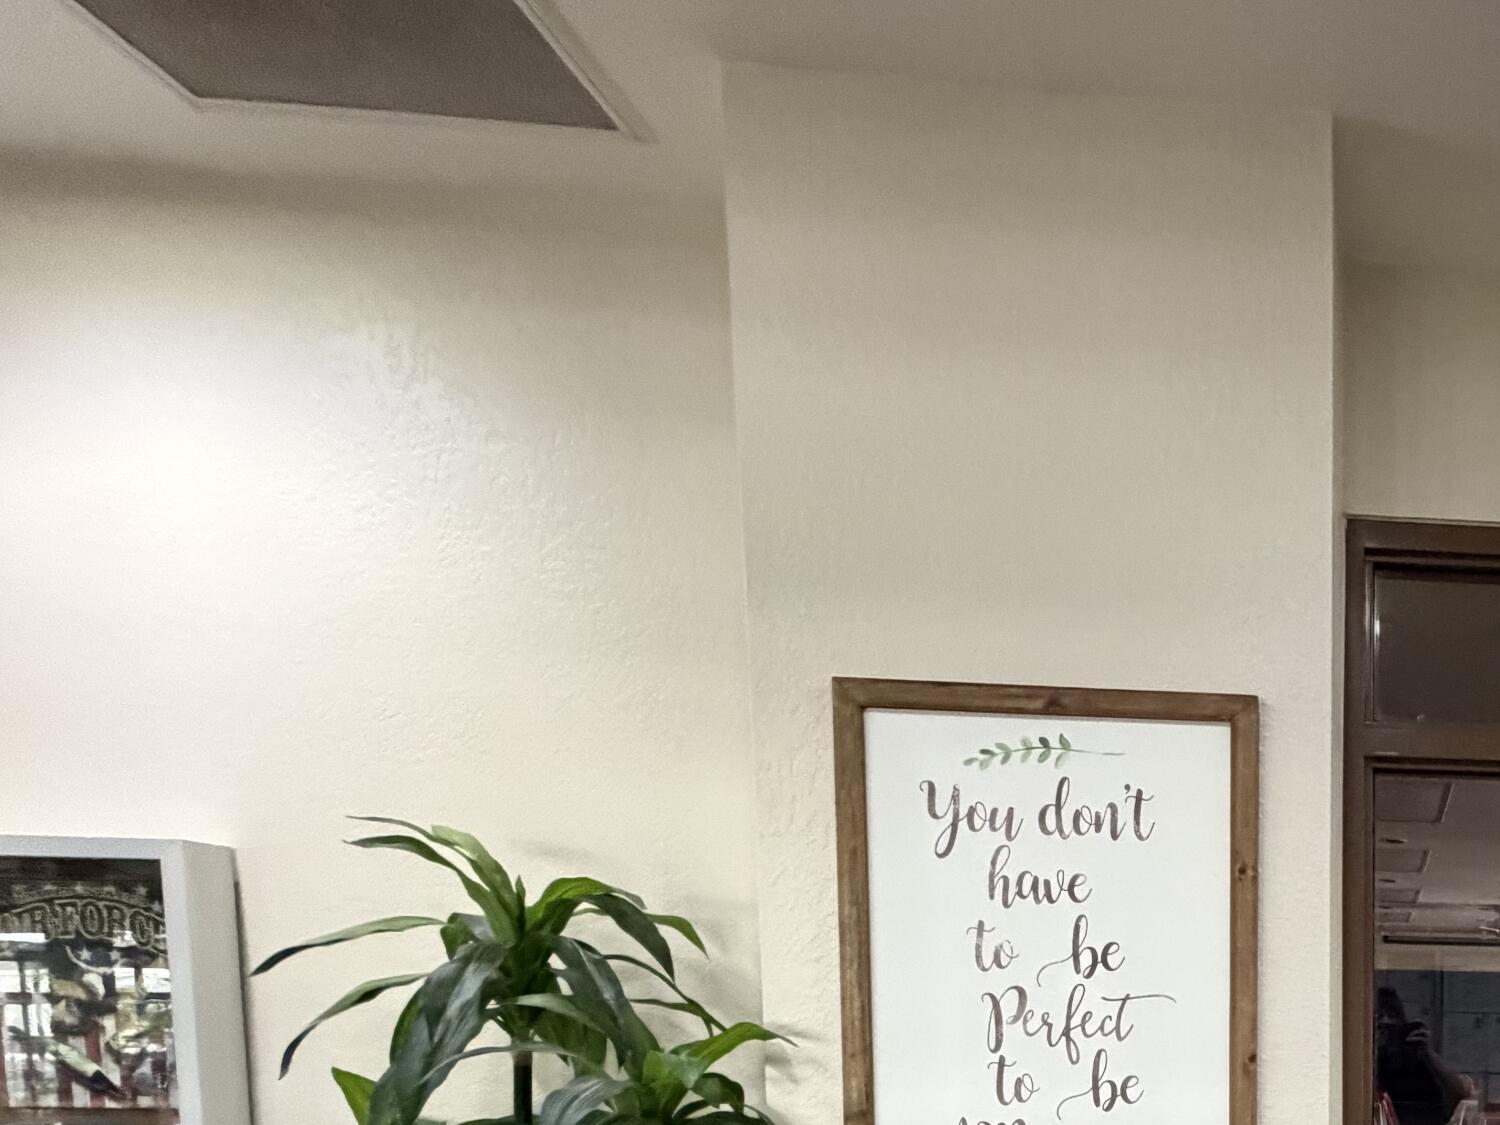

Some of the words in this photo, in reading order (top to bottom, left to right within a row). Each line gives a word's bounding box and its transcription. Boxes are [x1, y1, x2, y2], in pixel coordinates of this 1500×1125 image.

[919, 775, 1023, 858] You
[1038, 776, 1155, 842] don't
[987, 845, 1092, 908] have
[966, 919, 1019, 972] to
[1036, 914, 1125, 986] be
[981, 984, 1176, 1065] Perfect
[987, 1055, 1040, 1106] to
[1056, 1049, 1144, 1121] be
